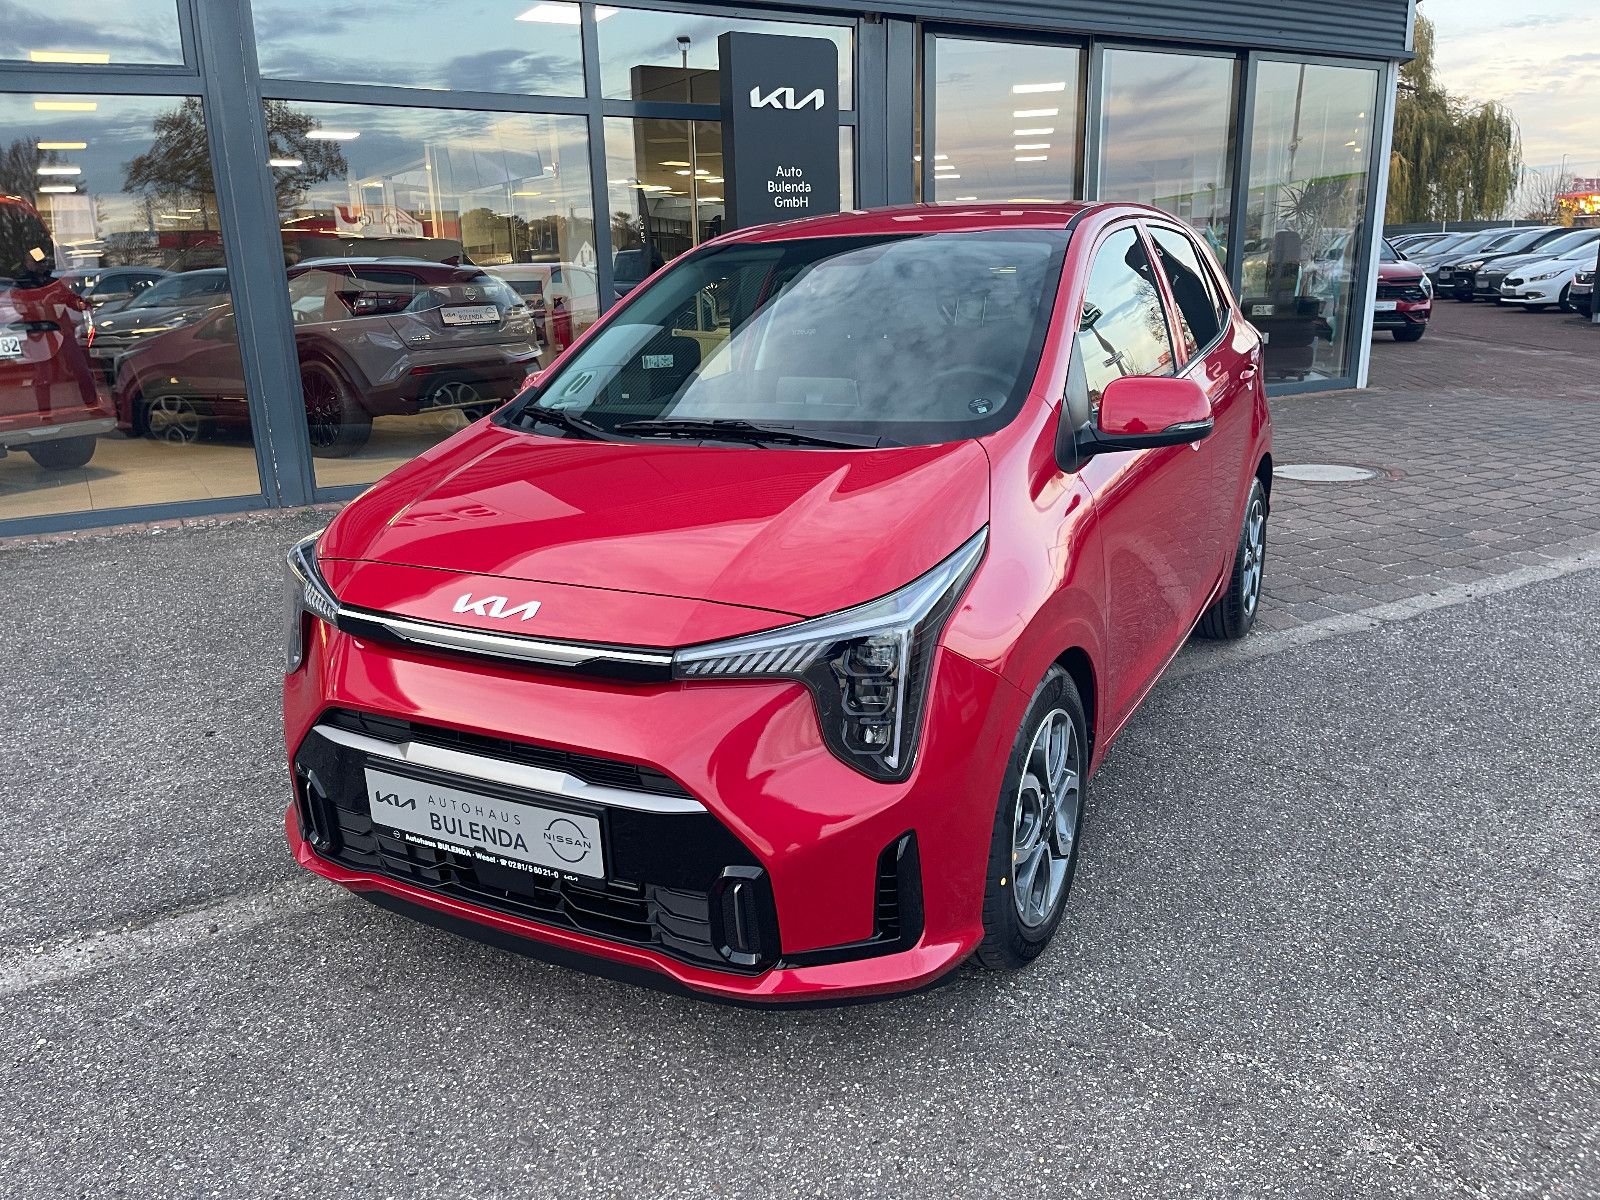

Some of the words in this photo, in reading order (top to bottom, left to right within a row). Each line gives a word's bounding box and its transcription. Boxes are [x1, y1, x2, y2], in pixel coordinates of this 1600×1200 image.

[749, 85, 825, 111] KIA
[775, 165, 803, 178] Auto
[767, 181, 812, 193] Bulenda
[774, 196, 809, 208] GmbH
[452, 592, 542, 621] KIA
[375, 790, 417, 811] KIA
[428, 794, 521, 826] AUTOHAUS
[429, 812, 529, 853] BULENDA
[543, 832, 591, 849] NISSAN
[437, 841, 472, 857] BULENDA
[474, 851, 496, 864] Wesel
